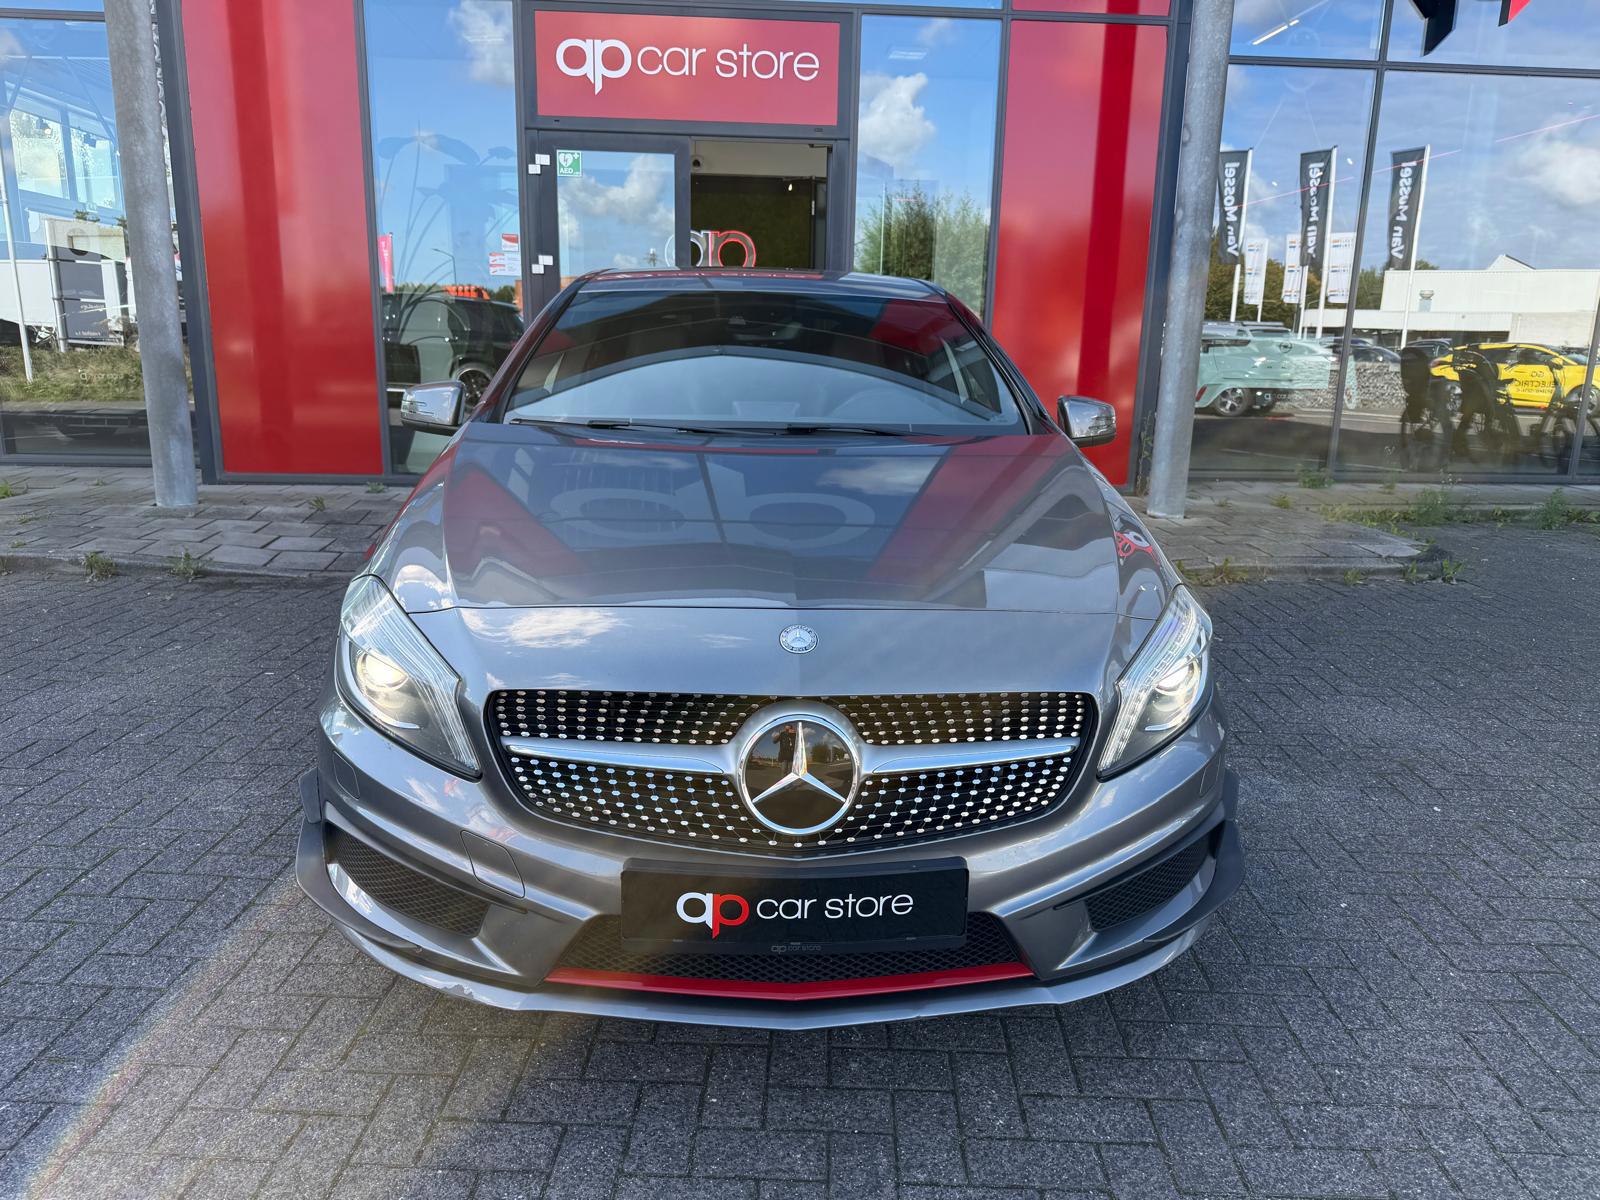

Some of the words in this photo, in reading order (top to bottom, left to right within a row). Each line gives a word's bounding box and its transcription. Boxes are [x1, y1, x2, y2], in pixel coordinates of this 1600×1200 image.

[555, 38, 632, 96] ap
[636, 45, 707, 77] car
[715, 43, 820, 82] store
[676, 891, 750, 940] ap
[756, 896, 818, 920] car
[823, 892, 914, 920] store
